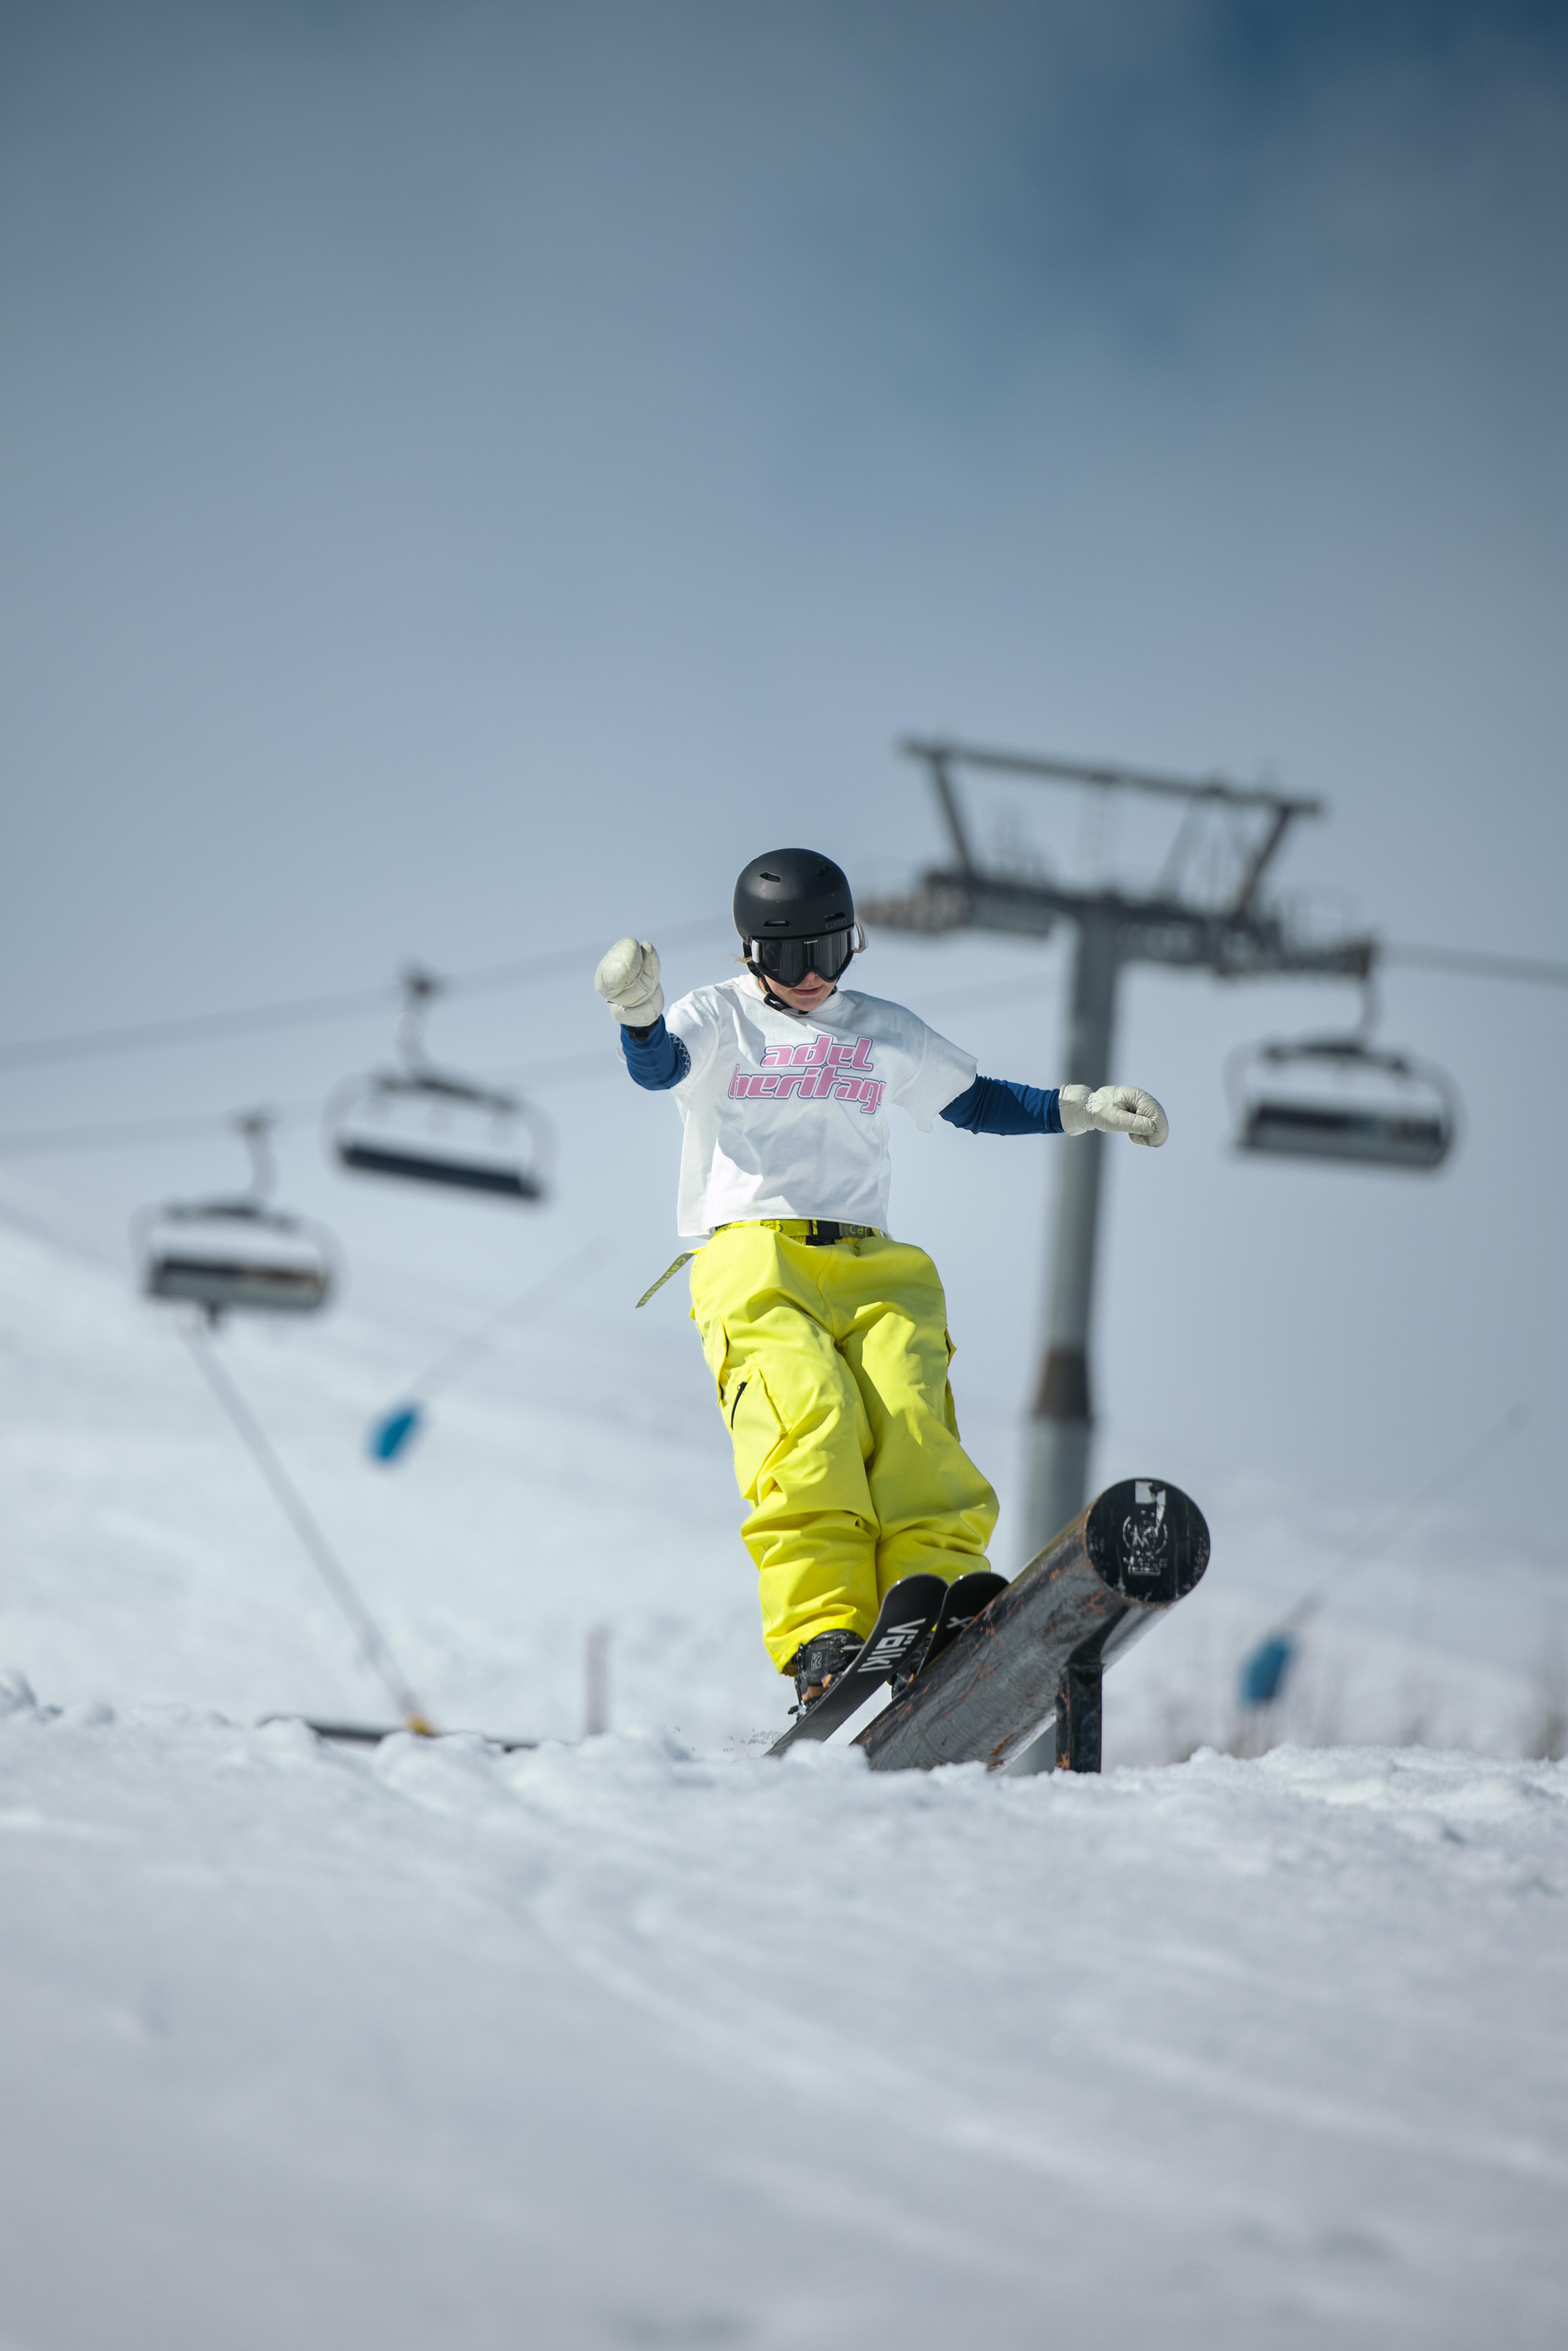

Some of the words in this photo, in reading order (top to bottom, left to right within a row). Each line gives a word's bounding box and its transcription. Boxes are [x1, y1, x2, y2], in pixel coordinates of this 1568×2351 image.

[825, 918, 847, 929] GIRO
[760, 1035, 873, 1071] adel
[811, 1651, 822, 1671] K2
